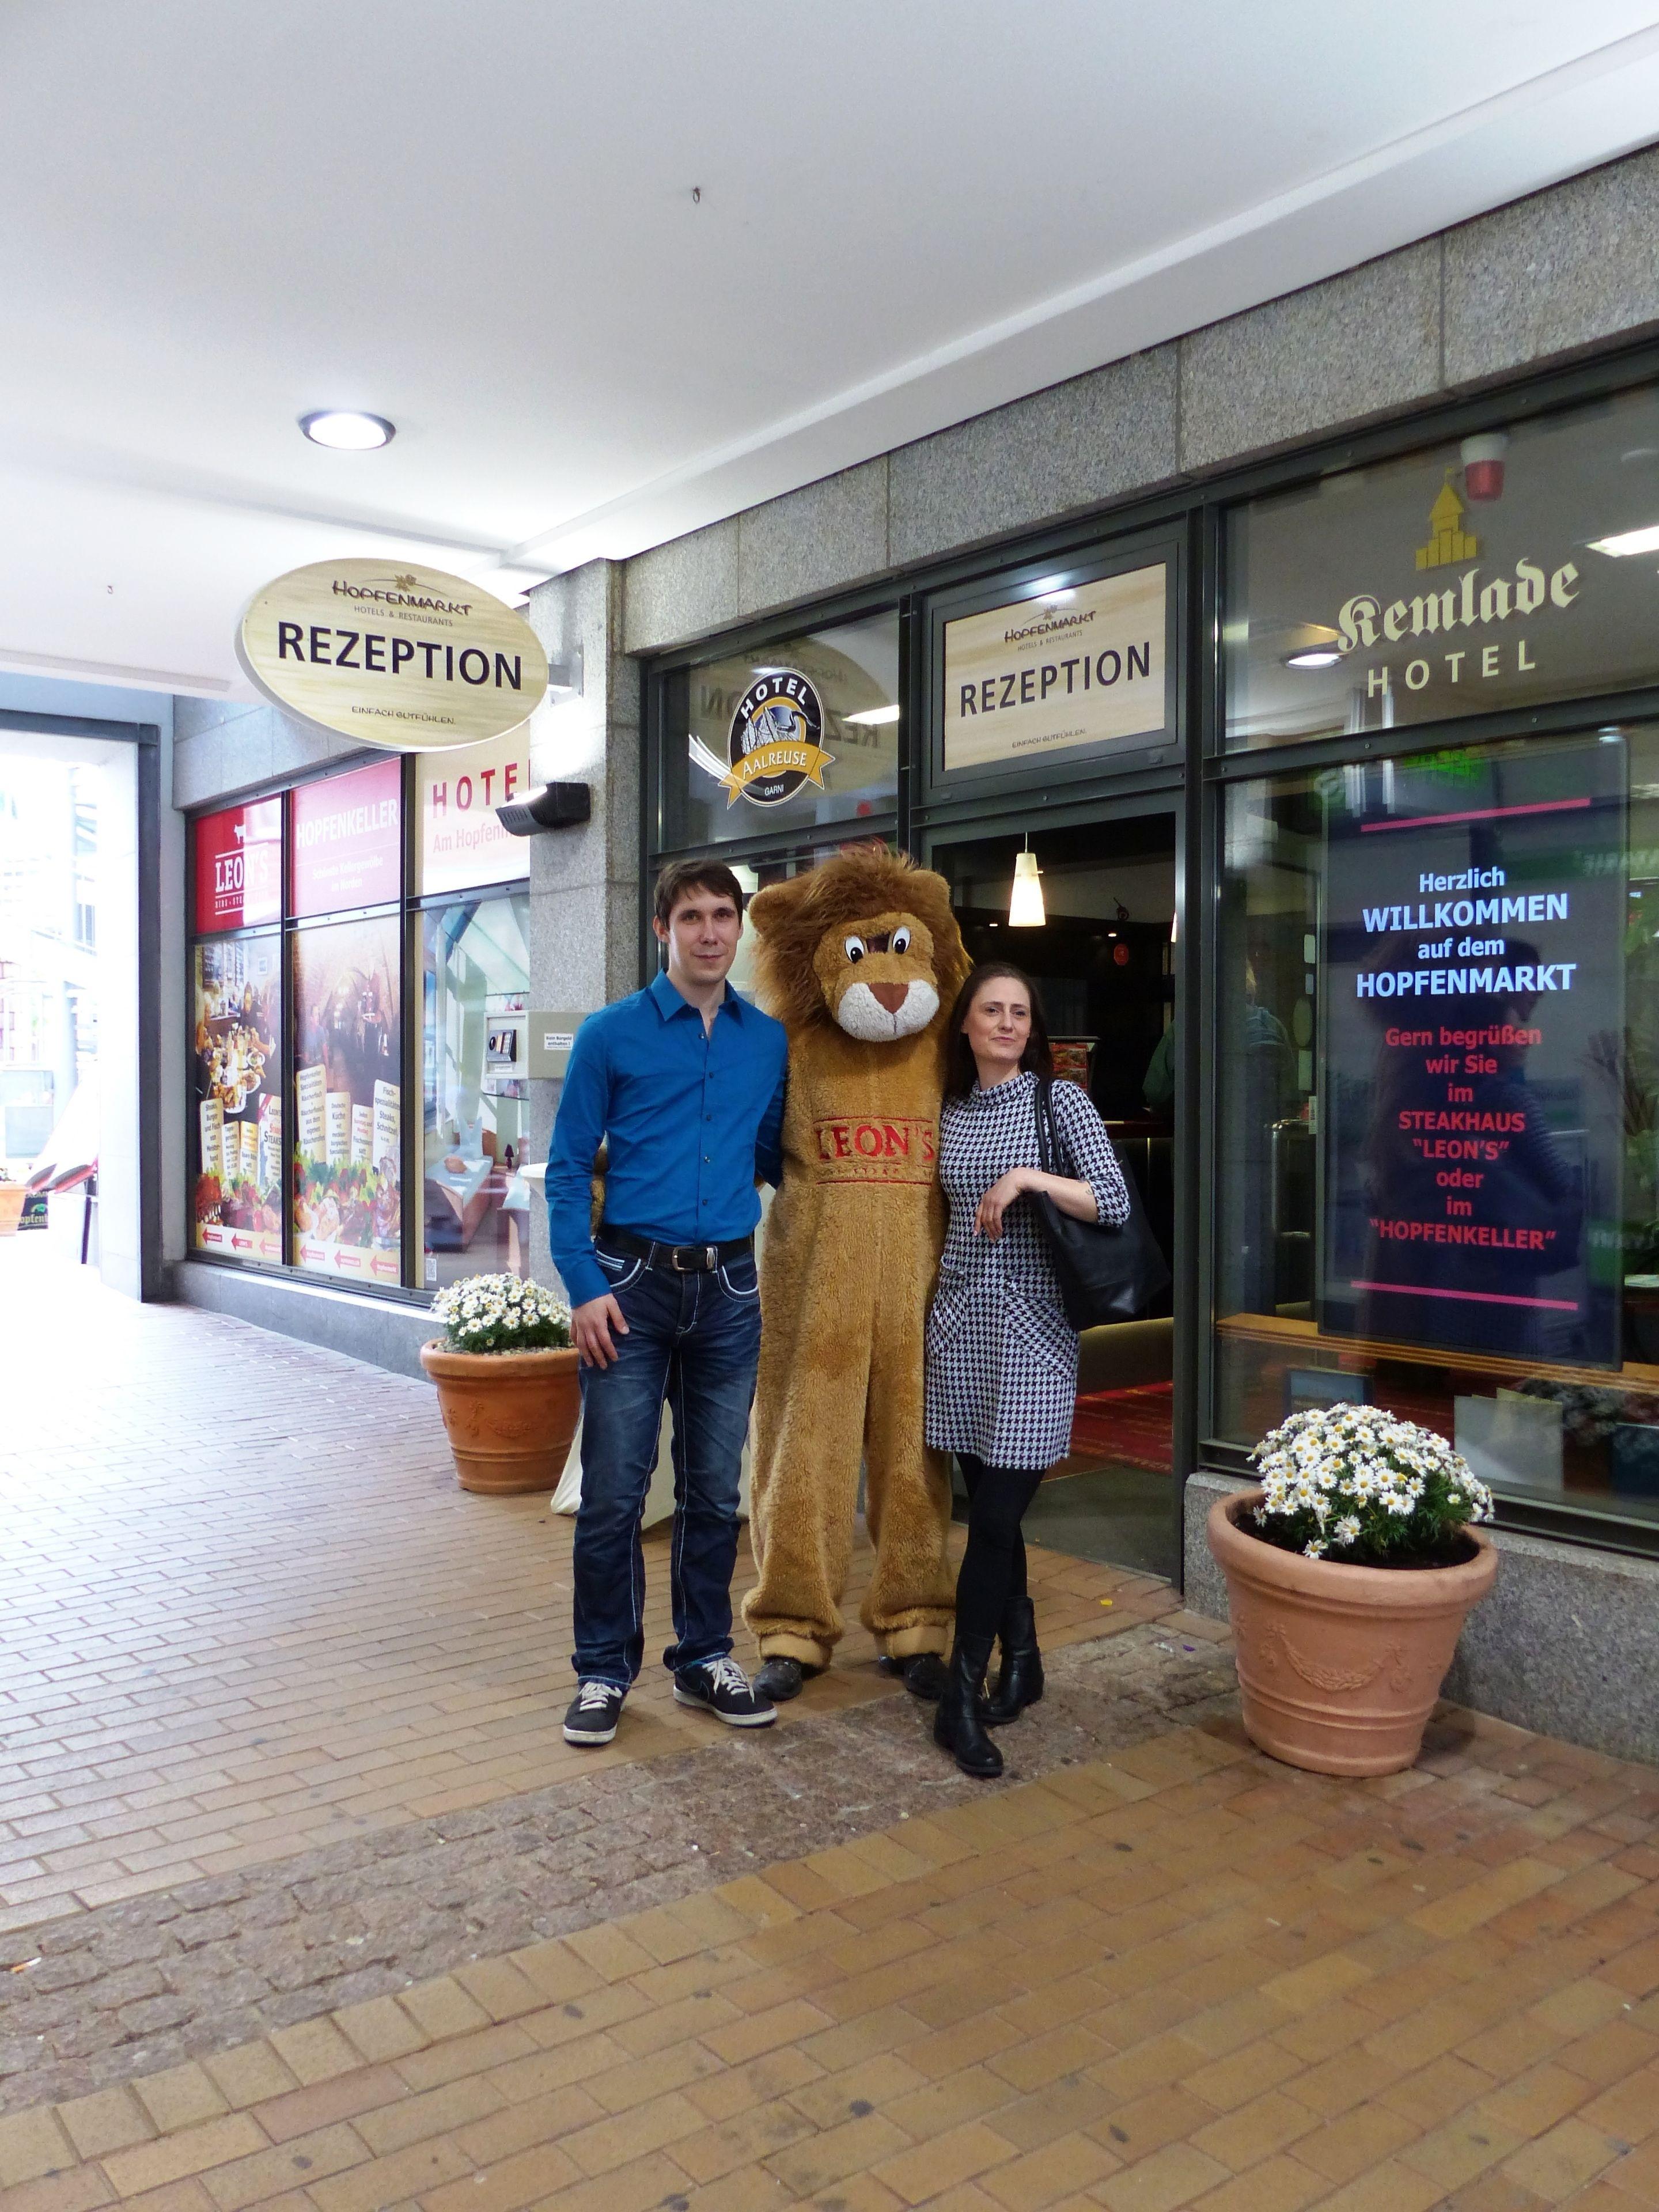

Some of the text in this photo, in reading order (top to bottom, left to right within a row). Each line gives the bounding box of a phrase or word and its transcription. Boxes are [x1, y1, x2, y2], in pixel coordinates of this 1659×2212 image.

[332, 581, 472, 616] HOPFENMARKT
[354, 605, 384, 618] HOTELS
[399, 612, 453, 627] RESTAURANTS
[1005, 611, 1096, 643] HOPFENMARKT
[1018, 641, 1037, 651] HOTELS
[1046, 631, 1083, 644] RESTAURANTS
[278, 621, 521, 691] REZEPTION
[960, 642, 1150, 717] REZEPTION
[1368, 640, 1536, 698] HOTEL
[741, 677, 807, 719] HOTEL
[352, 706, 393, 718] EINFACH
[1012, 737, 1041, 748] EINFACH
[743, 751, 807, 779] AALREUSE
[433, 759, 530, 819] HOTE
[764, 785, 784, 796] GARNI
[297, 798, 398, 849] HOPFENKELLER
[433, 834, 452, 853] Am
[1419, 866, 1505, 892] Herzlich
[1362, 893, 1568, 932] WILLKOMMEN
[1418, 937, 1505, 959] auf dem
[1357, 964, 1576, 997] HOPFENMARKT
[1385, 1024, 1542, 1049] Gern begrüßen
[1426, 1055, 1497, 1074] wir Sie
[1448, 1082, 1474, 1102] im
[1399, 1111, 1526, 1132] STEAKHAUS
[816, 1124, 935, 1161] LEON'S
[1412, 1138, 1509, 1161] "LEON'S"
[1436, 1168, 1484, 1189] oder
[1446, 1196, 1472, 1216] im
[1369, 1218, 1556, 1250] "HOPFENKELLER"
